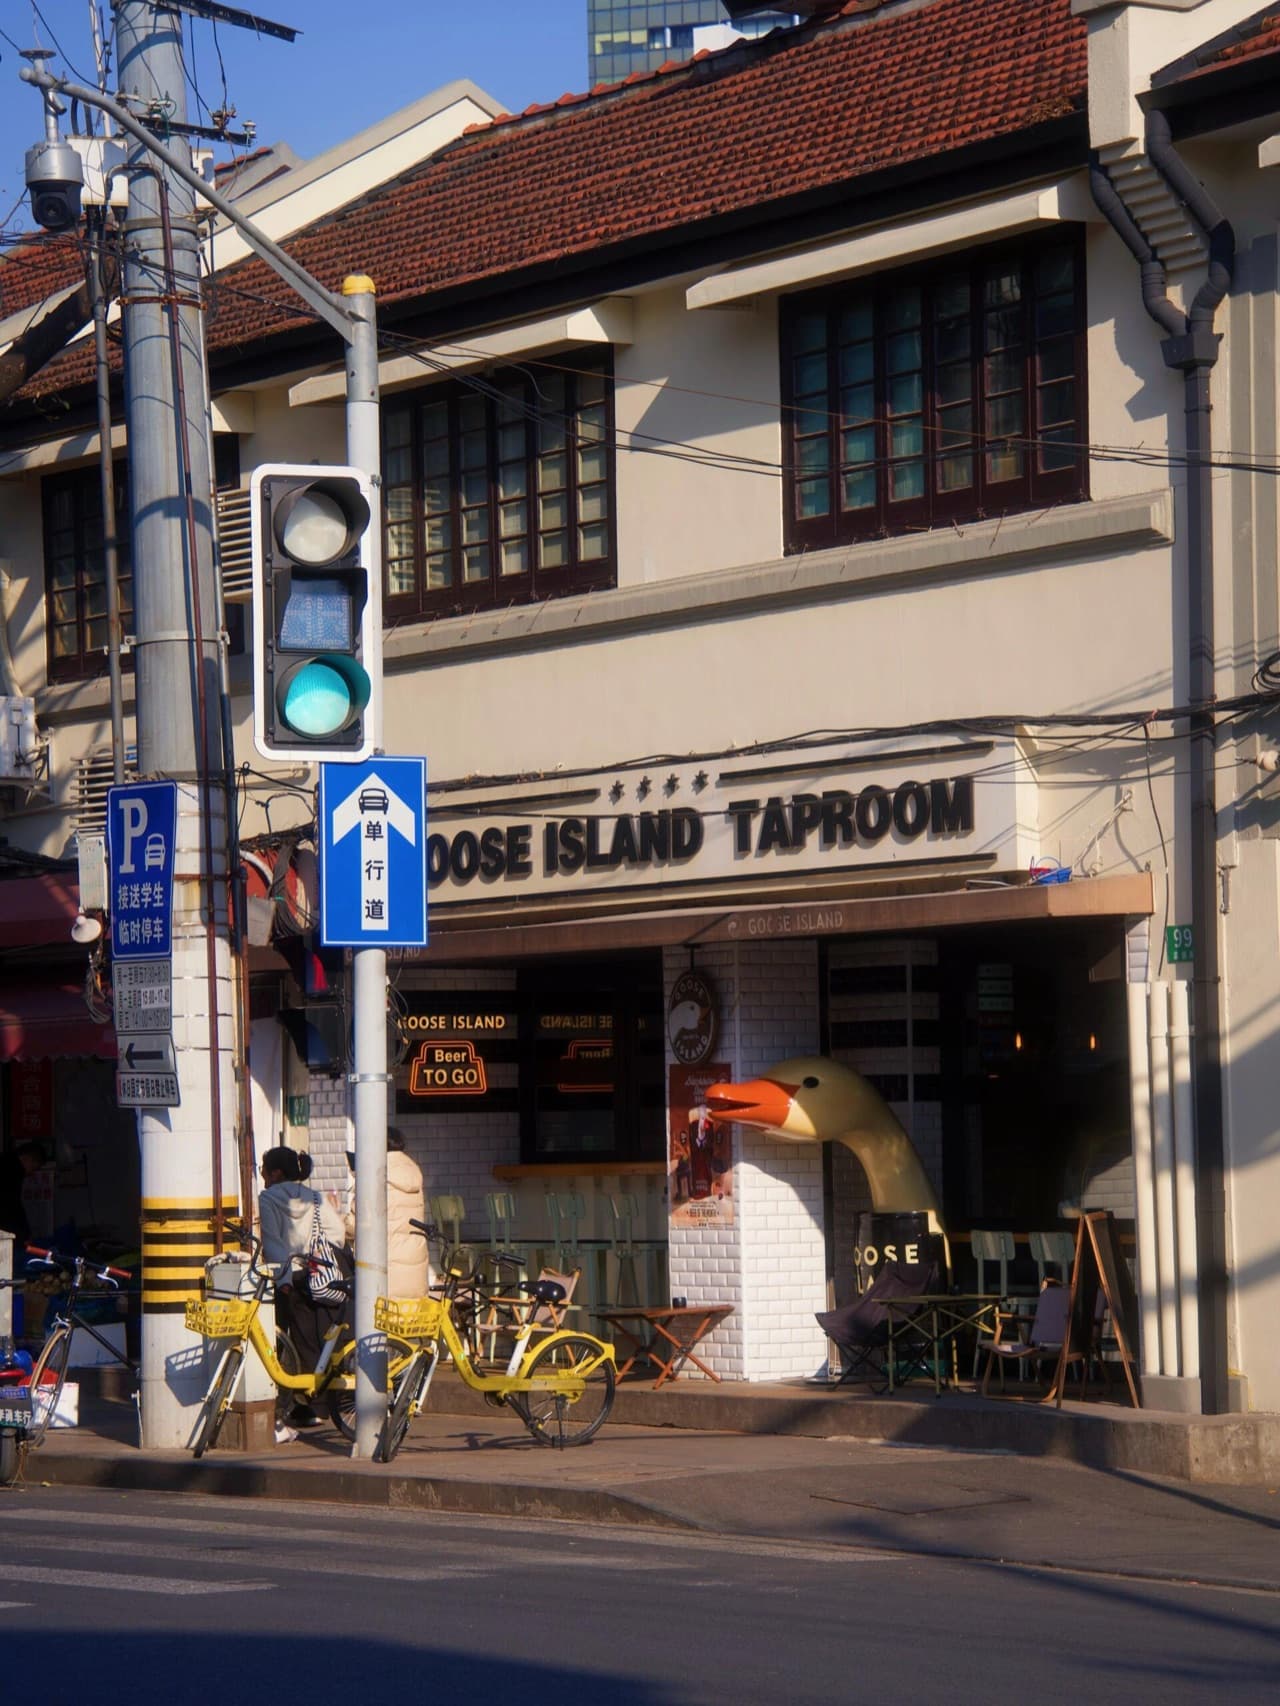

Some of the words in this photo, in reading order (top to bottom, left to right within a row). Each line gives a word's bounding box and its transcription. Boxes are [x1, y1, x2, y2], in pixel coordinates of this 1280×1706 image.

[119, 798, 148, 874] P
[428, 824, 531, 882] OOSE
[546, 807, 704, 871] ISLAND
[728, 776, 974, 852] TAPROOM
[364, 820, 385, 920] 单行道
[118, 881, 164, 911] 接送学生
[796, 911, 843, 930] ISLAND
[118, 917, 164, 945] 临时停车
[1173, 928, 1193, 948] 99
[386, 945, 420, 960] SLAND
[453, 1015, 505, 1029] ISLAND
[435, 1049, 467, 1062] Beer
[423, 1069, 448, 1085] TO
[452, 1069, 478, 1085] GO
